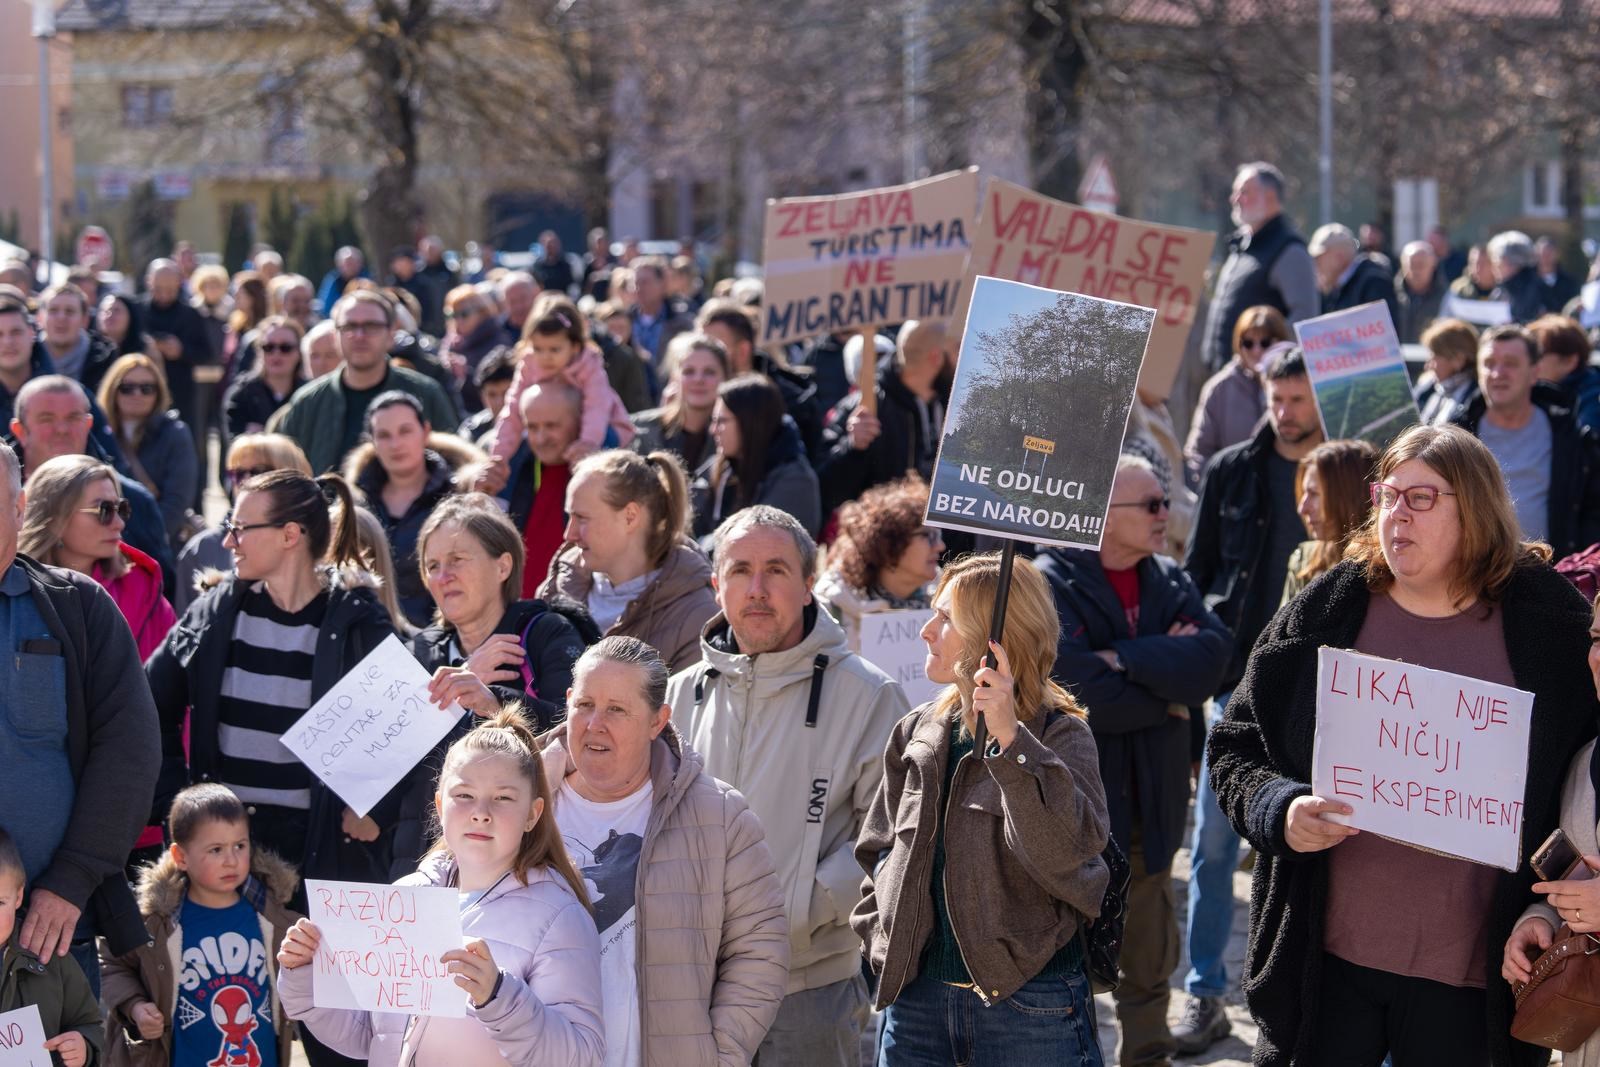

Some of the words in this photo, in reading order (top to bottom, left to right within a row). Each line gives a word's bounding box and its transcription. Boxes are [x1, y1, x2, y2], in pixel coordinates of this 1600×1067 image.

[809, 218, 969, 261] TURISTIMA
[1125, 229, 1188, 279] SE
[844, 258, 895, 288] NE
[989, 244, 1004, 276] I
[1016, 249, 1062, 288] MI
[764, 279, 962, 341] MIGRANTIMI
[959, 463, 992, 485] NE
[997, 470, 1085, 500] ODLUCI
[935, 493, 978, 516] BEZ
[982, 500, 1102, 534] NARODA!!!
[877, 619, 928, 645] AND
[299, 694, 353, 750] ZAŠTO
[358, 664, 384, 692] NE
[383, 679, 410, 701] ZA
[1331, 660, 1414, 709] LIKA
[1456, 690, 1508, 730] NIJE
[1378, 718, 1461, 773] NIČIJI
[1333, 765, 1525, 834] EKSPERIMENT
[317, 888, 416, 924] RAZVOJ
[368, 925, 408, 951] DA
[319, 946, 451, 979] IMPROVIZACIJ
[377, 982, 414, 1008] NE
